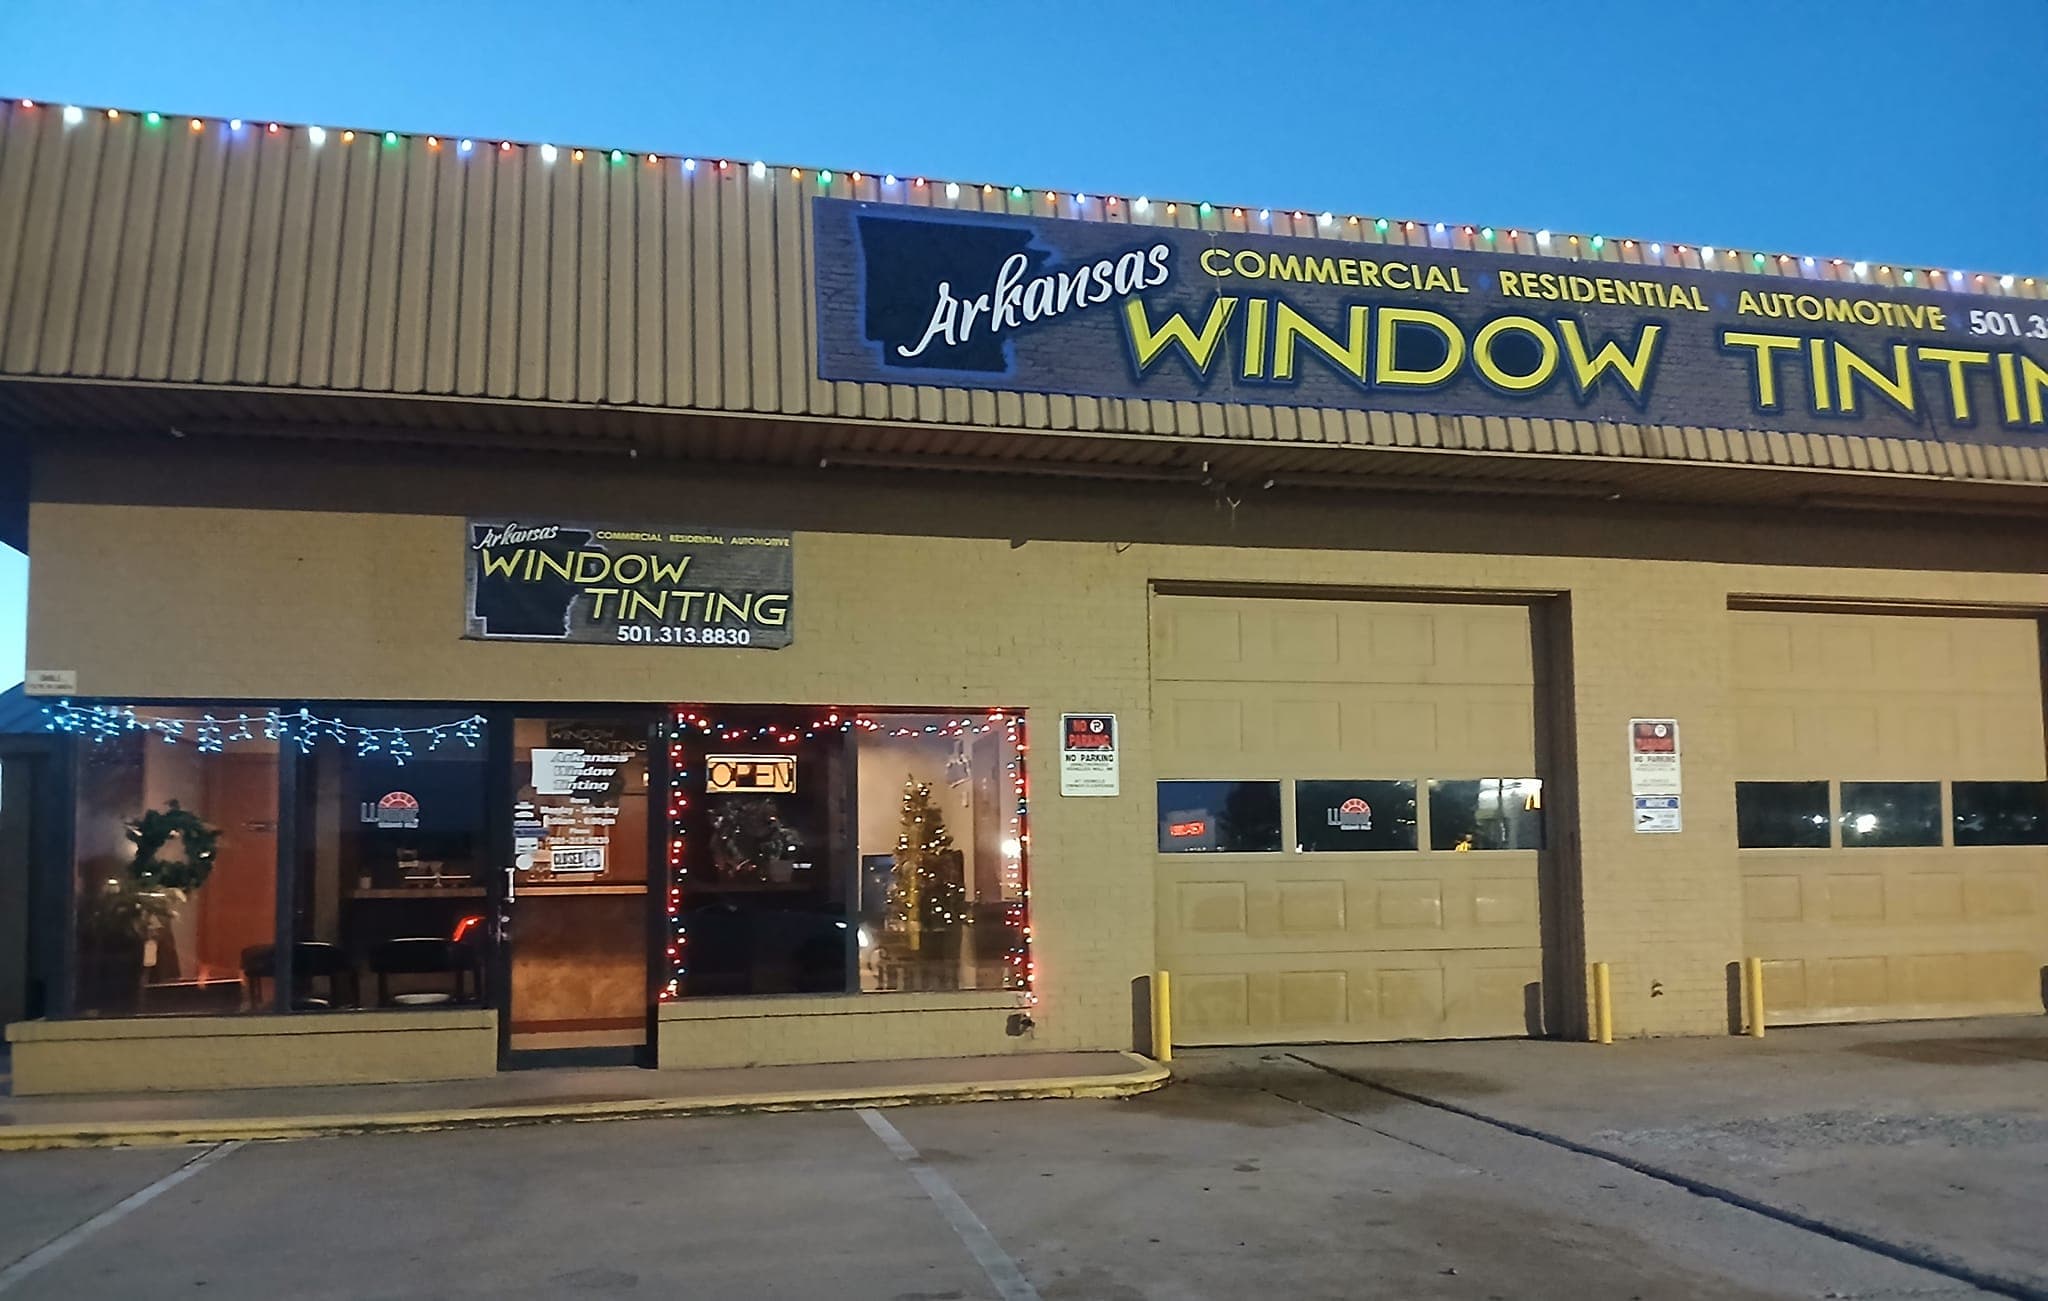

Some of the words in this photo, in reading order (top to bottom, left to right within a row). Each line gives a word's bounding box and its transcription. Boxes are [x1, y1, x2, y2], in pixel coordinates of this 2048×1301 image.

[897, 243, 1169, 358] Arkansas
[1200, 248, 1467, 292] COMMERCIAL
[1500, 270, 1708, 312] RESIDENTIAL
[1737, 290, 1946, 332] AUTOMOTIVE
[1967, 309, 2048, 340] 501.3
[1123, 294, 1661, 390] WINDOW
[473, 523, 558, 549] Arkansas
[596, 530, 662, 542] COMMERCIAL
[669, 533, 724, 545] RESIDENTIAL
[731, 536, 790, 547] AUTOMOTIVE
[481, 548, 691, 584] WINDOW
[584, 587, 789, 626] TINTING
[616, 625, 750, 645] 501.313.8830
[553, 765, 616, 777] Window
[1065, 754, 1076, 762] NO
[1080, 754, 1113, 762] PARKING
[708, 762, 790, 788] OPEN
